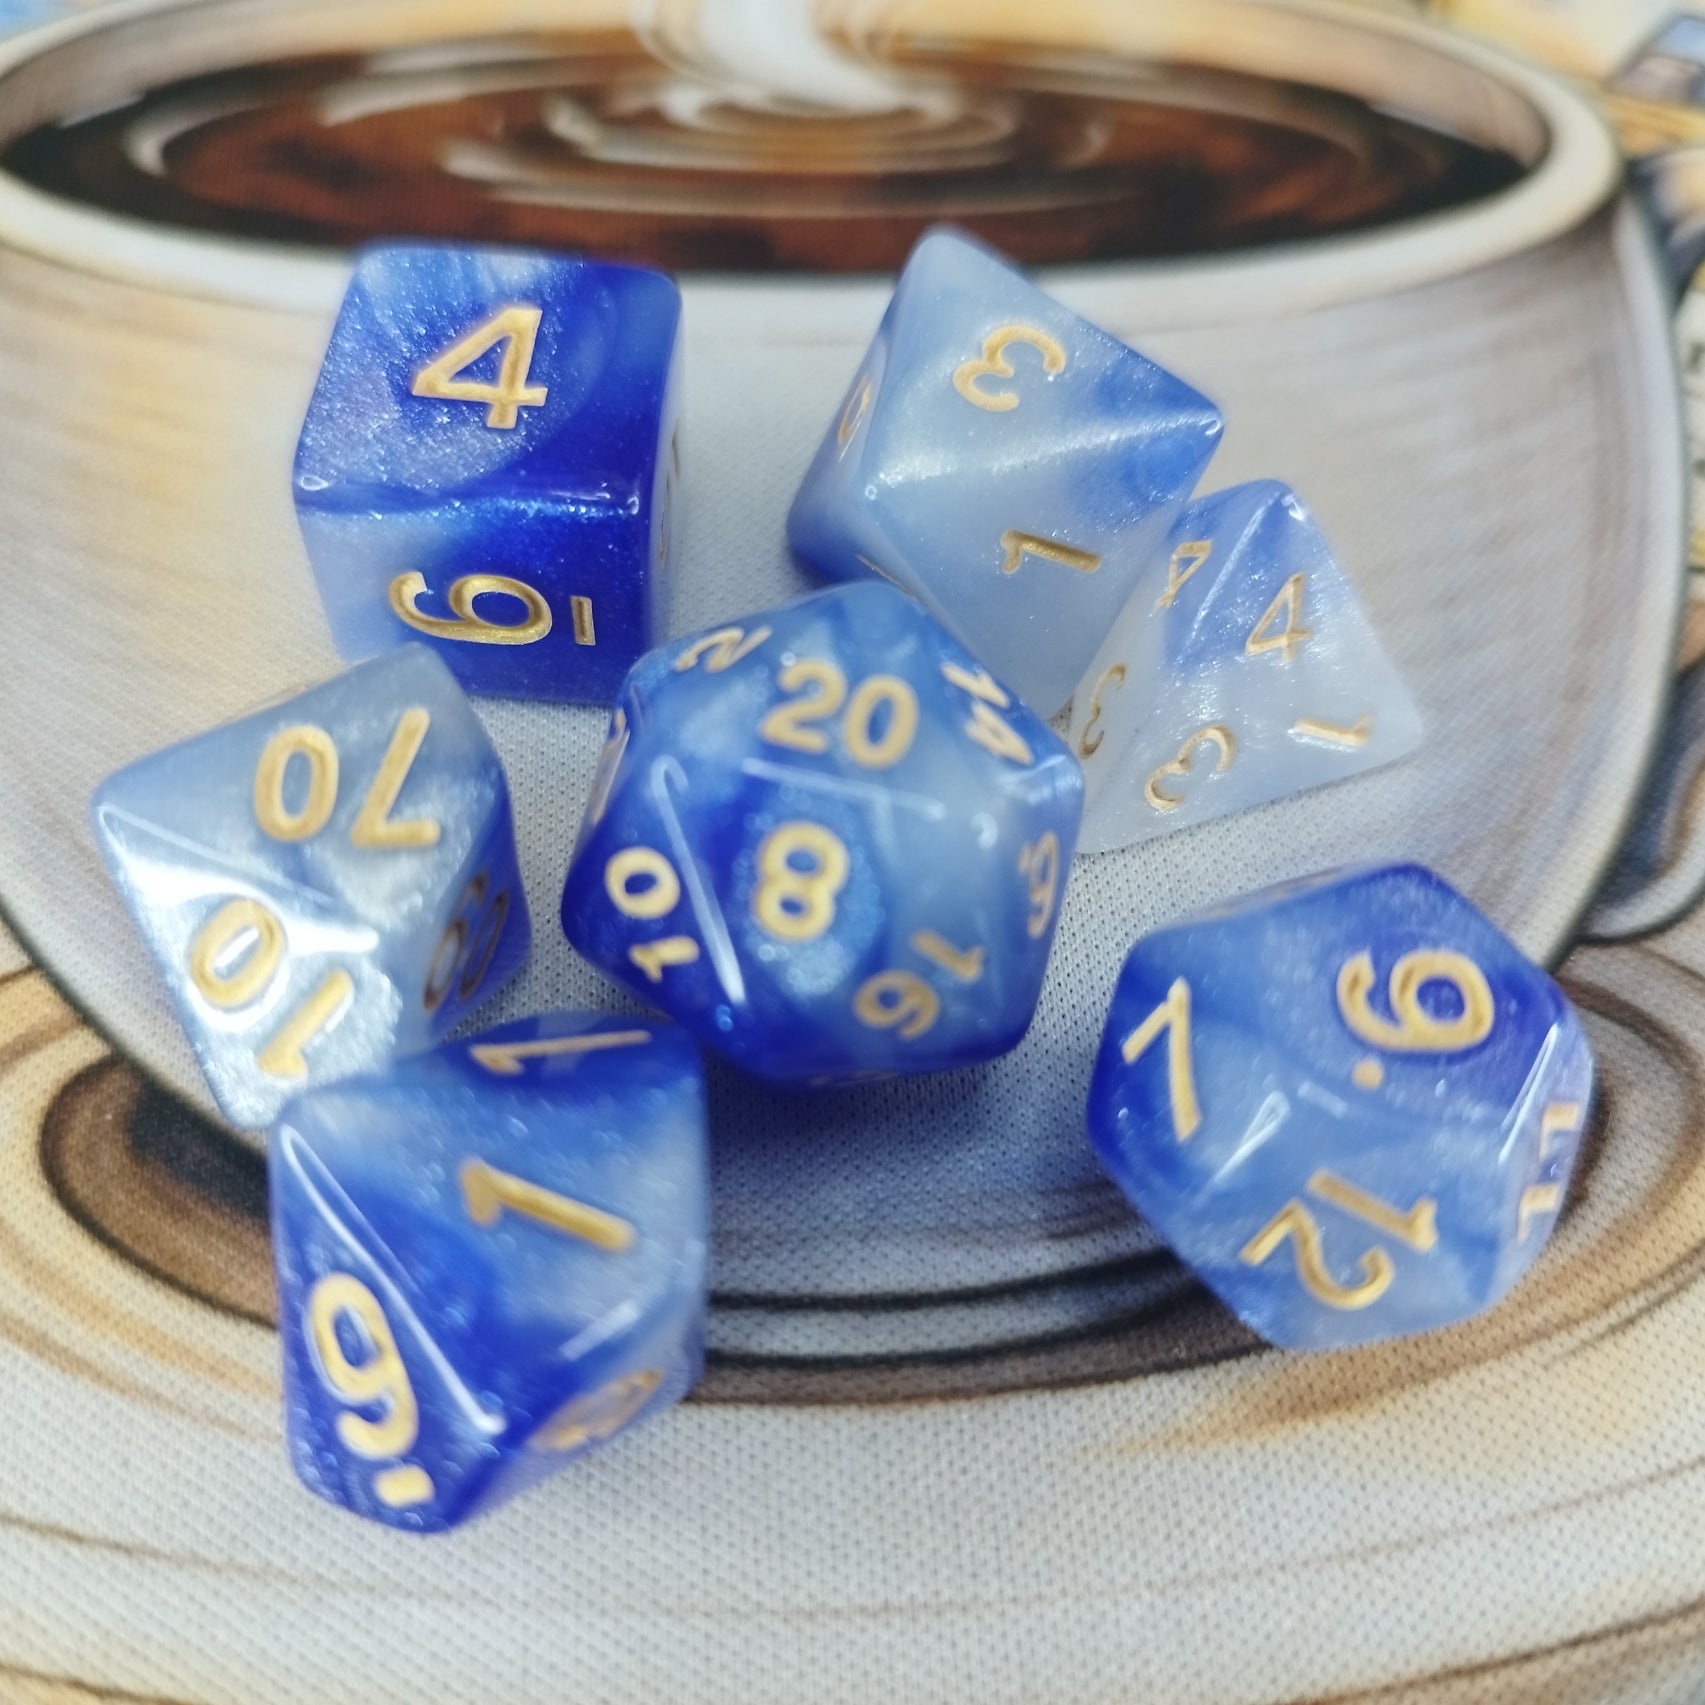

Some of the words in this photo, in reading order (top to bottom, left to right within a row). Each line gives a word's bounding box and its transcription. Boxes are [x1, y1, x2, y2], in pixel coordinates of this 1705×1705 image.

[412, 307, 549, 430] 4
[952, 324, 1066, 413] 3
[1002, 528, 1101, 575] 1
[674, 625, 774, 674] 2
[1244, 571, 1311, 666] 4
[757, 659, 920, 770] 20
[1143, 724, 1237, 812] 3
[252, 705, 442, 849] 70
[603, 845, 701, 984] 10
[751, 819, 851, 943] 8
[188, 895, 354, 1083] 10
[851, 927, 985, 1040] 16
[458, 1156, 638, 1253] 1
[1238, 1167, 1440, 1312] 12
